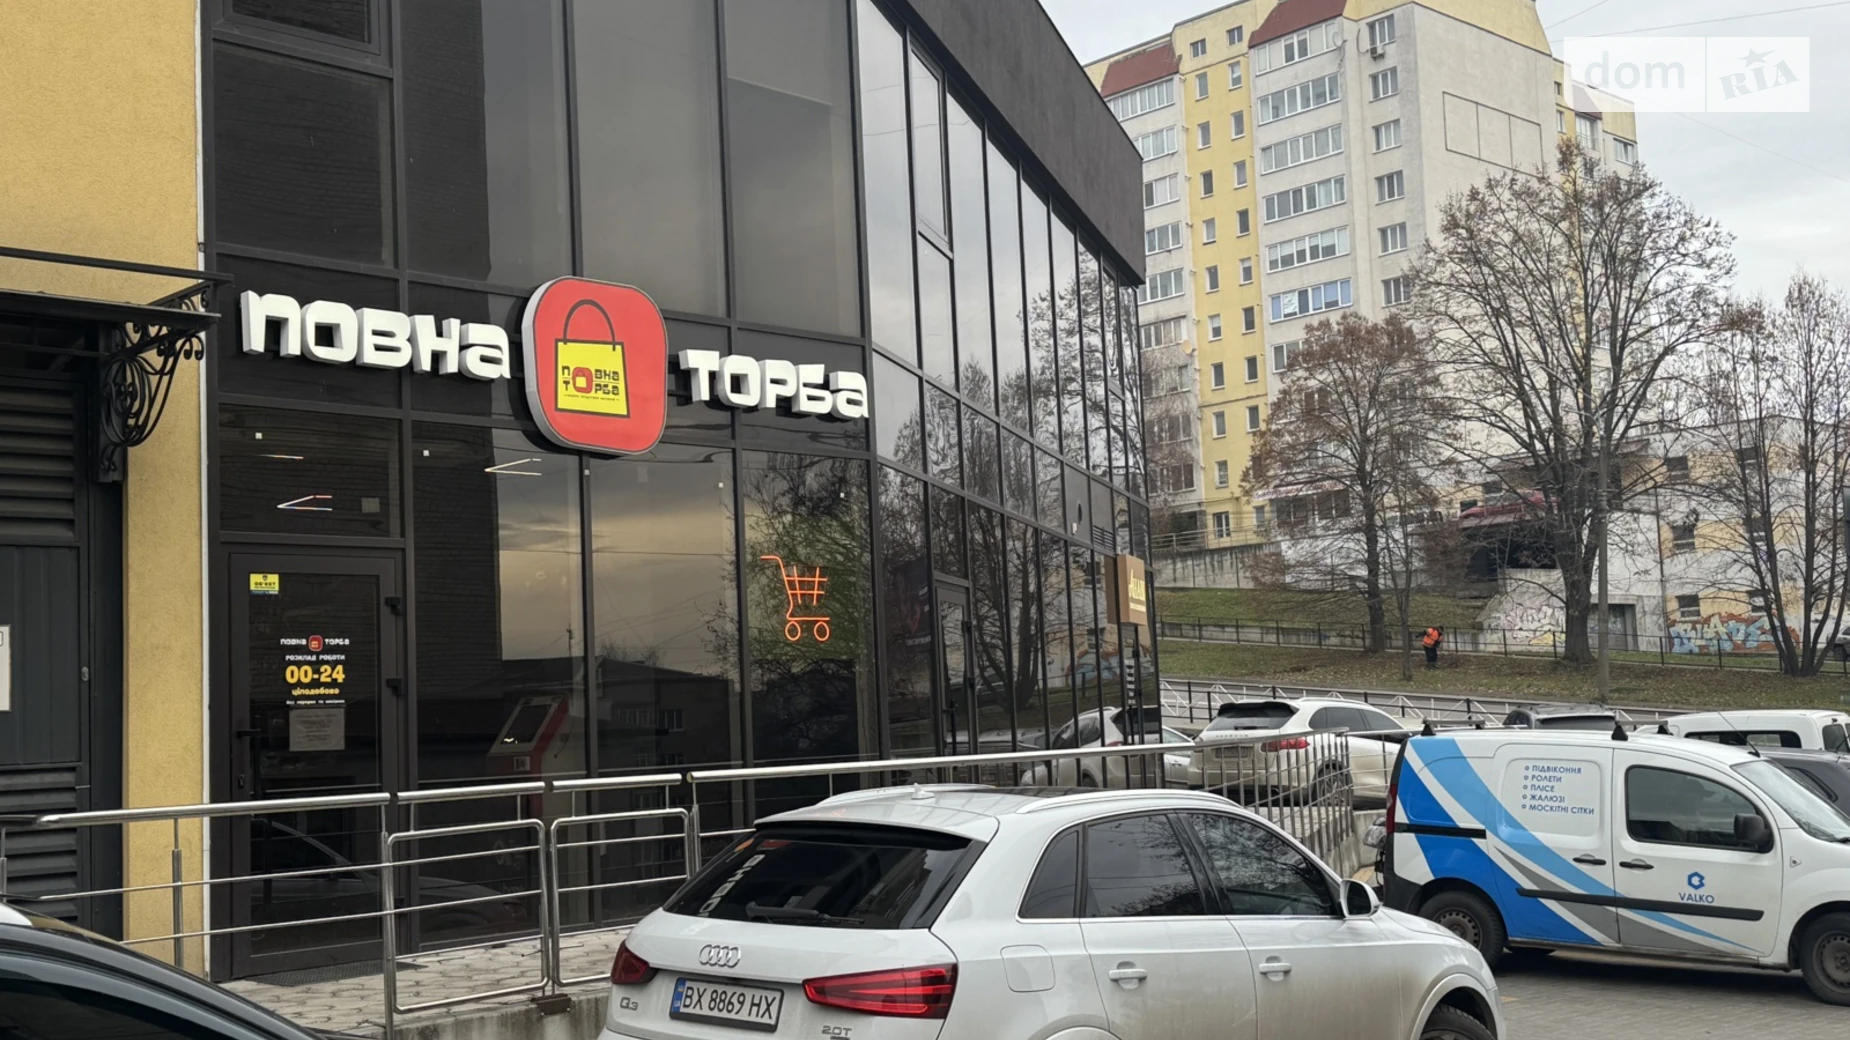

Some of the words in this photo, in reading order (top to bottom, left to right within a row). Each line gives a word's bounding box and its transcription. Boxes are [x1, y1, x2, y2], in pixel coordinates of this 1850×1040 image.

[285, 664, 346, 684] 00-24
[1531, 764, 1583, 775] ПІДВІКОННЯ
[1531, 774, 1563, 783] РОЛЕТИ
[1530, 784, 1556, 793] ПЛІСЕ
[1529, 793, 1566, 803] ЖАЛЮЗІ
[1528, 804, 1569, 814] МОСКІТНІ
[1570, 806, 1595, 816] СІТКИ
[1678, 892, 1715, 904] VALKO
[620, 996, 638, 1011] Q3
[682, 985, 707, 1011] BX
[708, 989, 747, 1015] 8869
[748, 994, 777, 1019] HX
